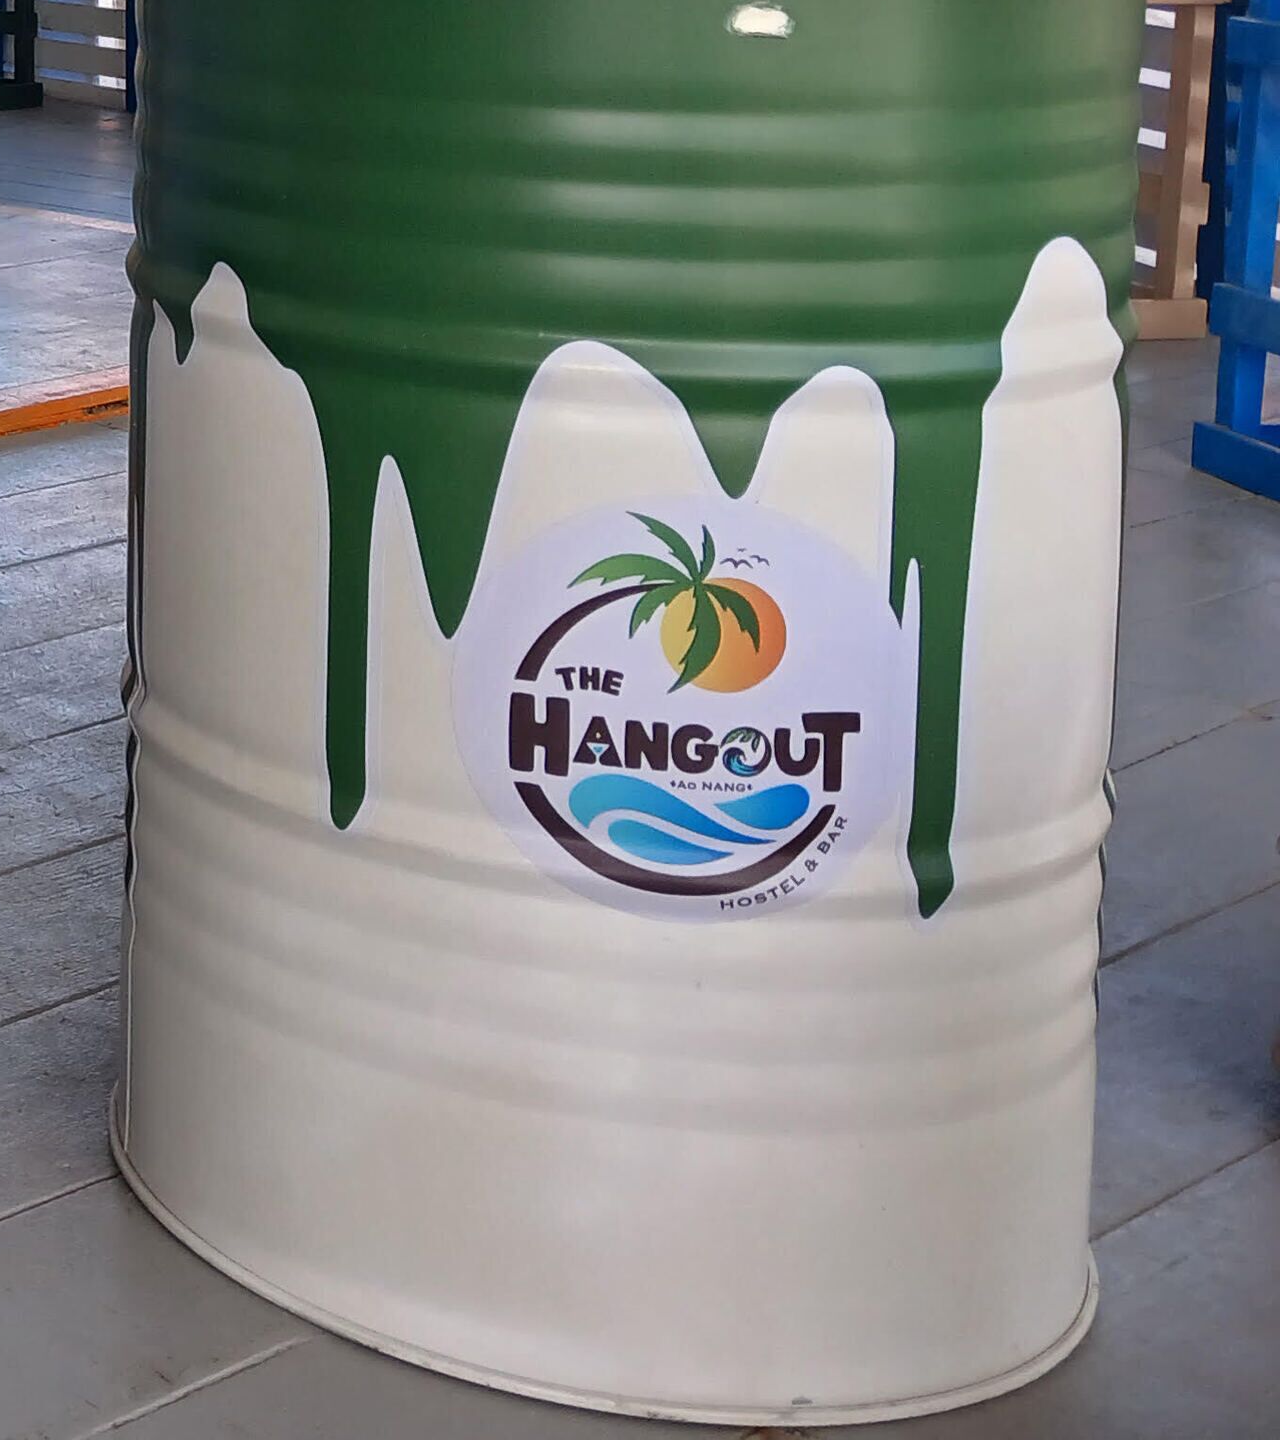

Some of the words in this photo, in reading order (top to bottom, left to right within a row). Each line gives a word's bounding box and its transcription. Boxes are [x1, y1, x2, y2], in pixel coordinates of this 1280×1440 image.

[554, 665, 625, 697] THE
[508, 691, 862, 793] HANGOUT
[702, 781, 745, 792] NANG
[720, 874, 806, 911] HOSTEL
[816, 815, 848, 855] BAR
